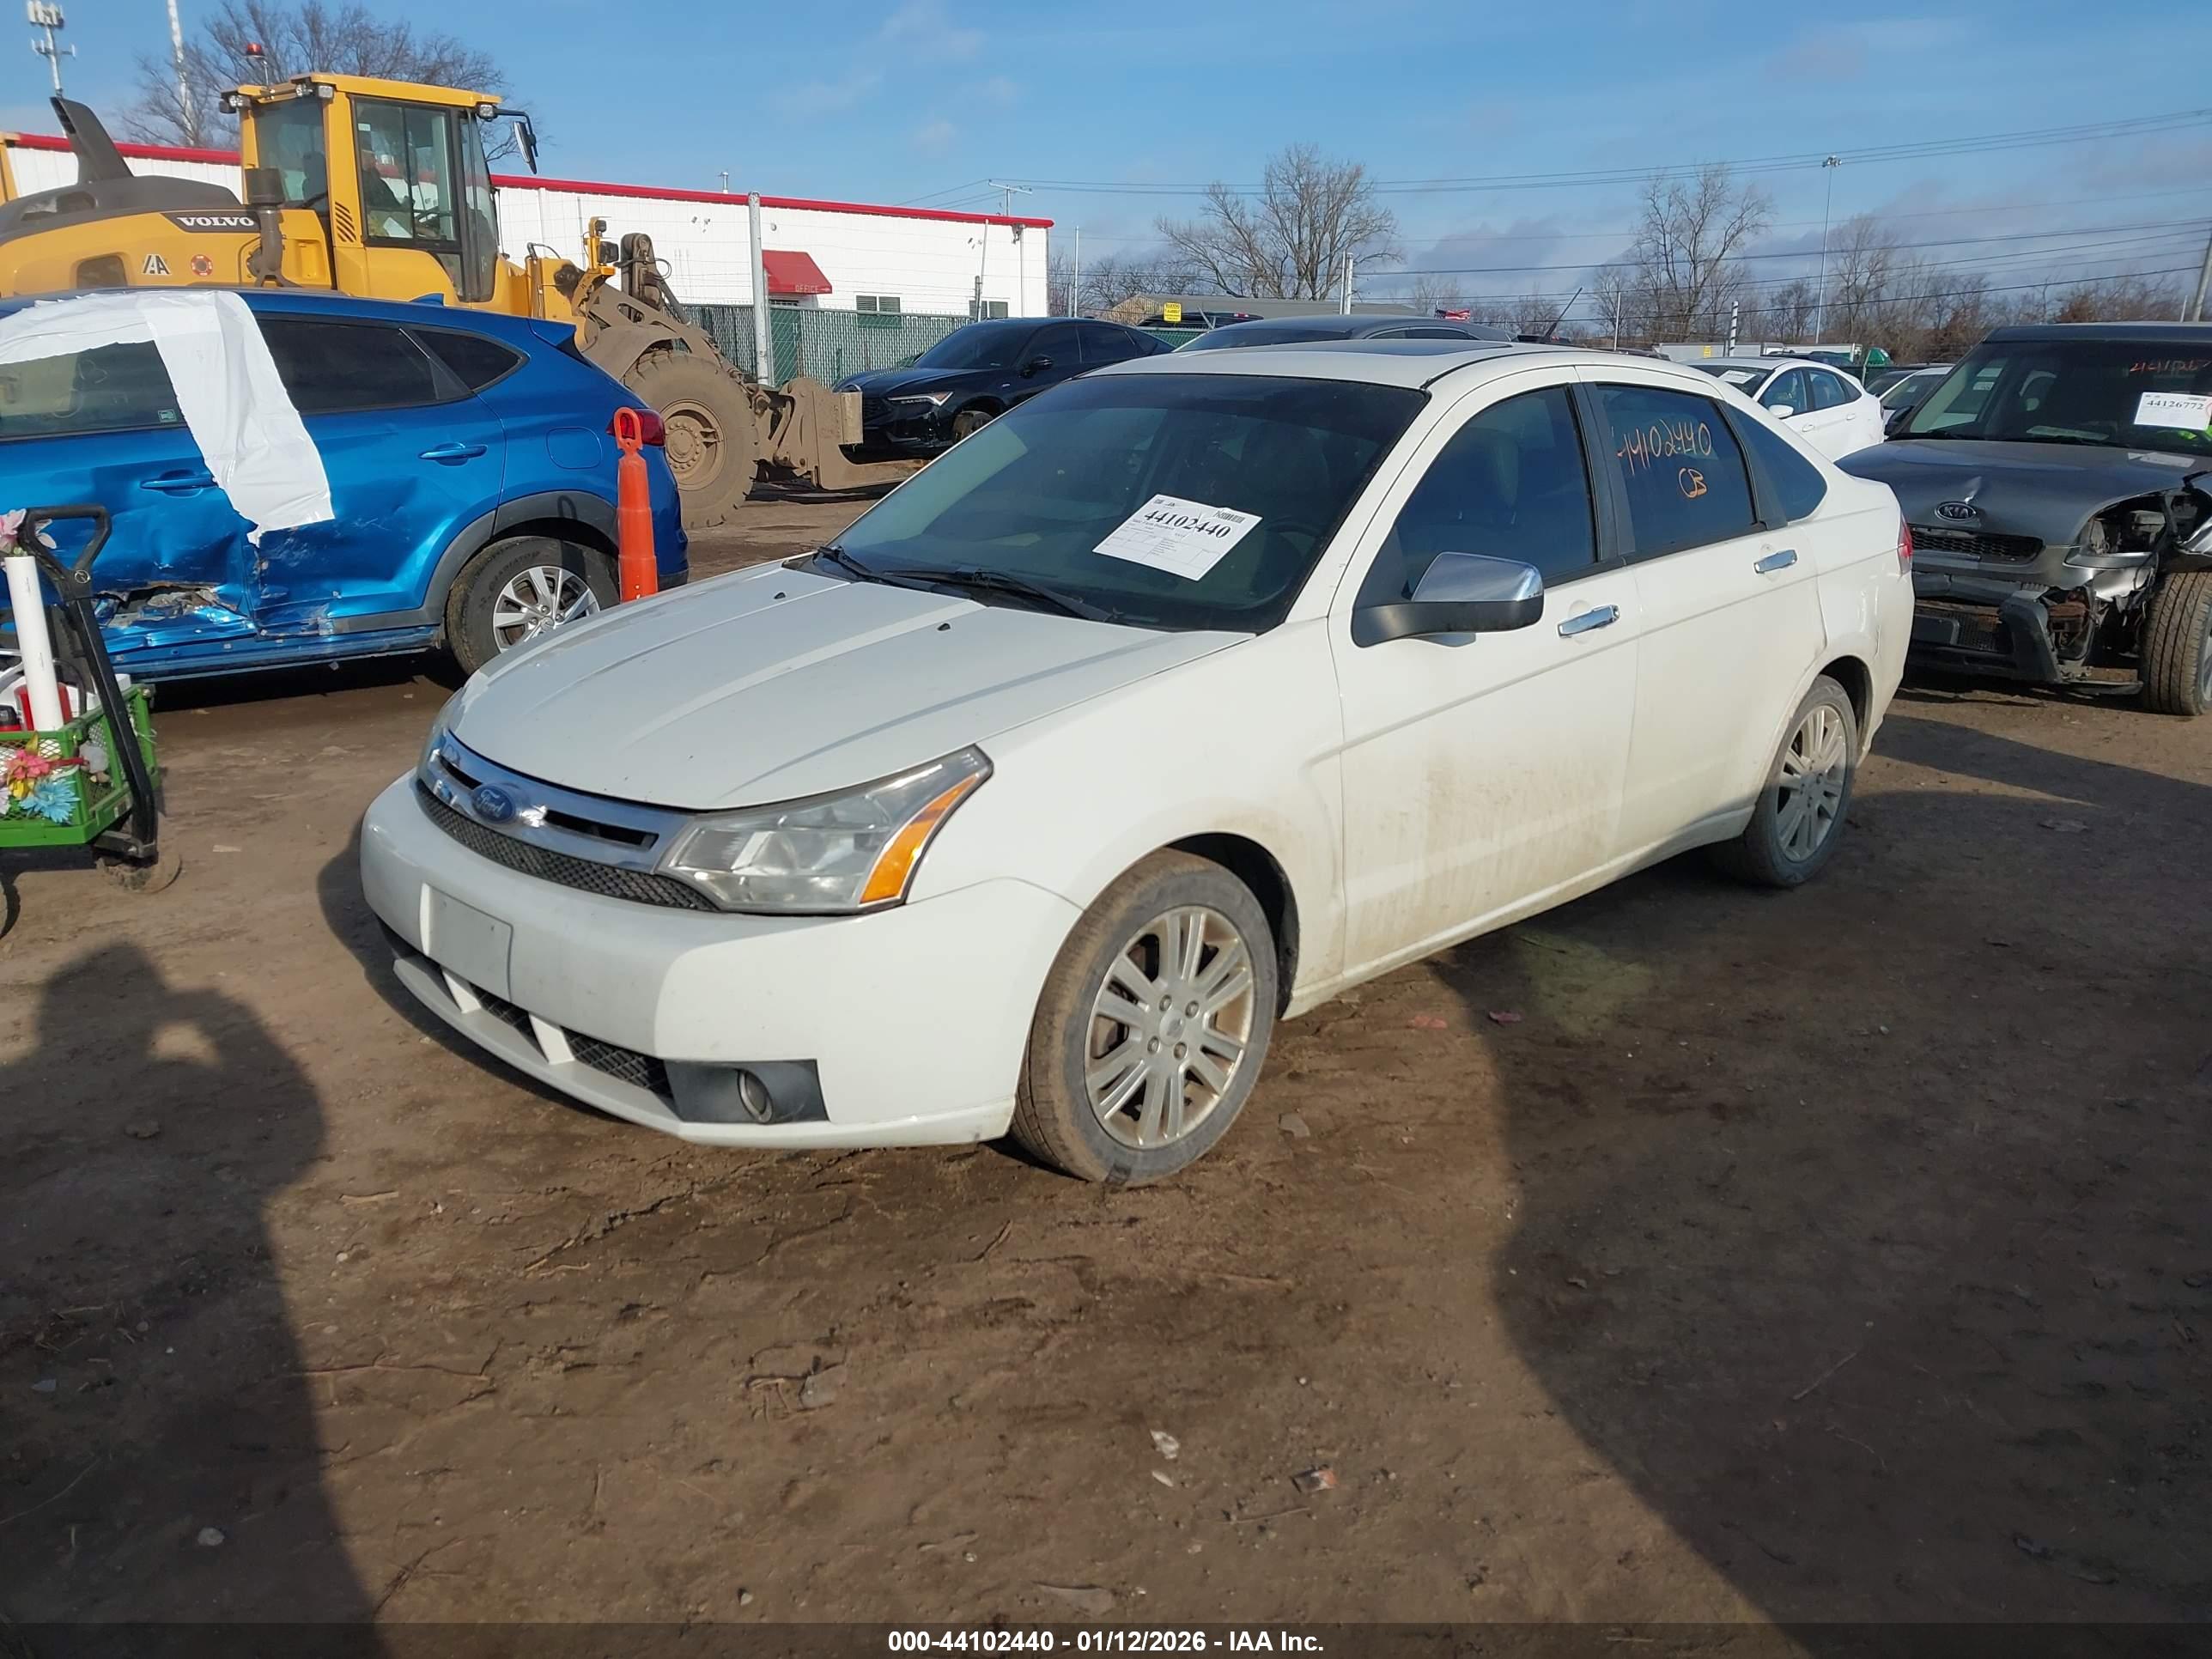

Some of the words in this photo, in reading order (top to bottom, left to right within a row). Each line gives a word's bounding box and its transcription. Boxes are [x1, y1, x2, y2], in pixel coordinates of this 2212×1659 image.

[177, 216, 255, 227] VOLVO
[2147, 400, 2203, 410] 44126772
[1943, 506, 1969, 517] KIA
[1144, 510, 1231, 538] 44102440
[480, 789, 506, 818] Ford
